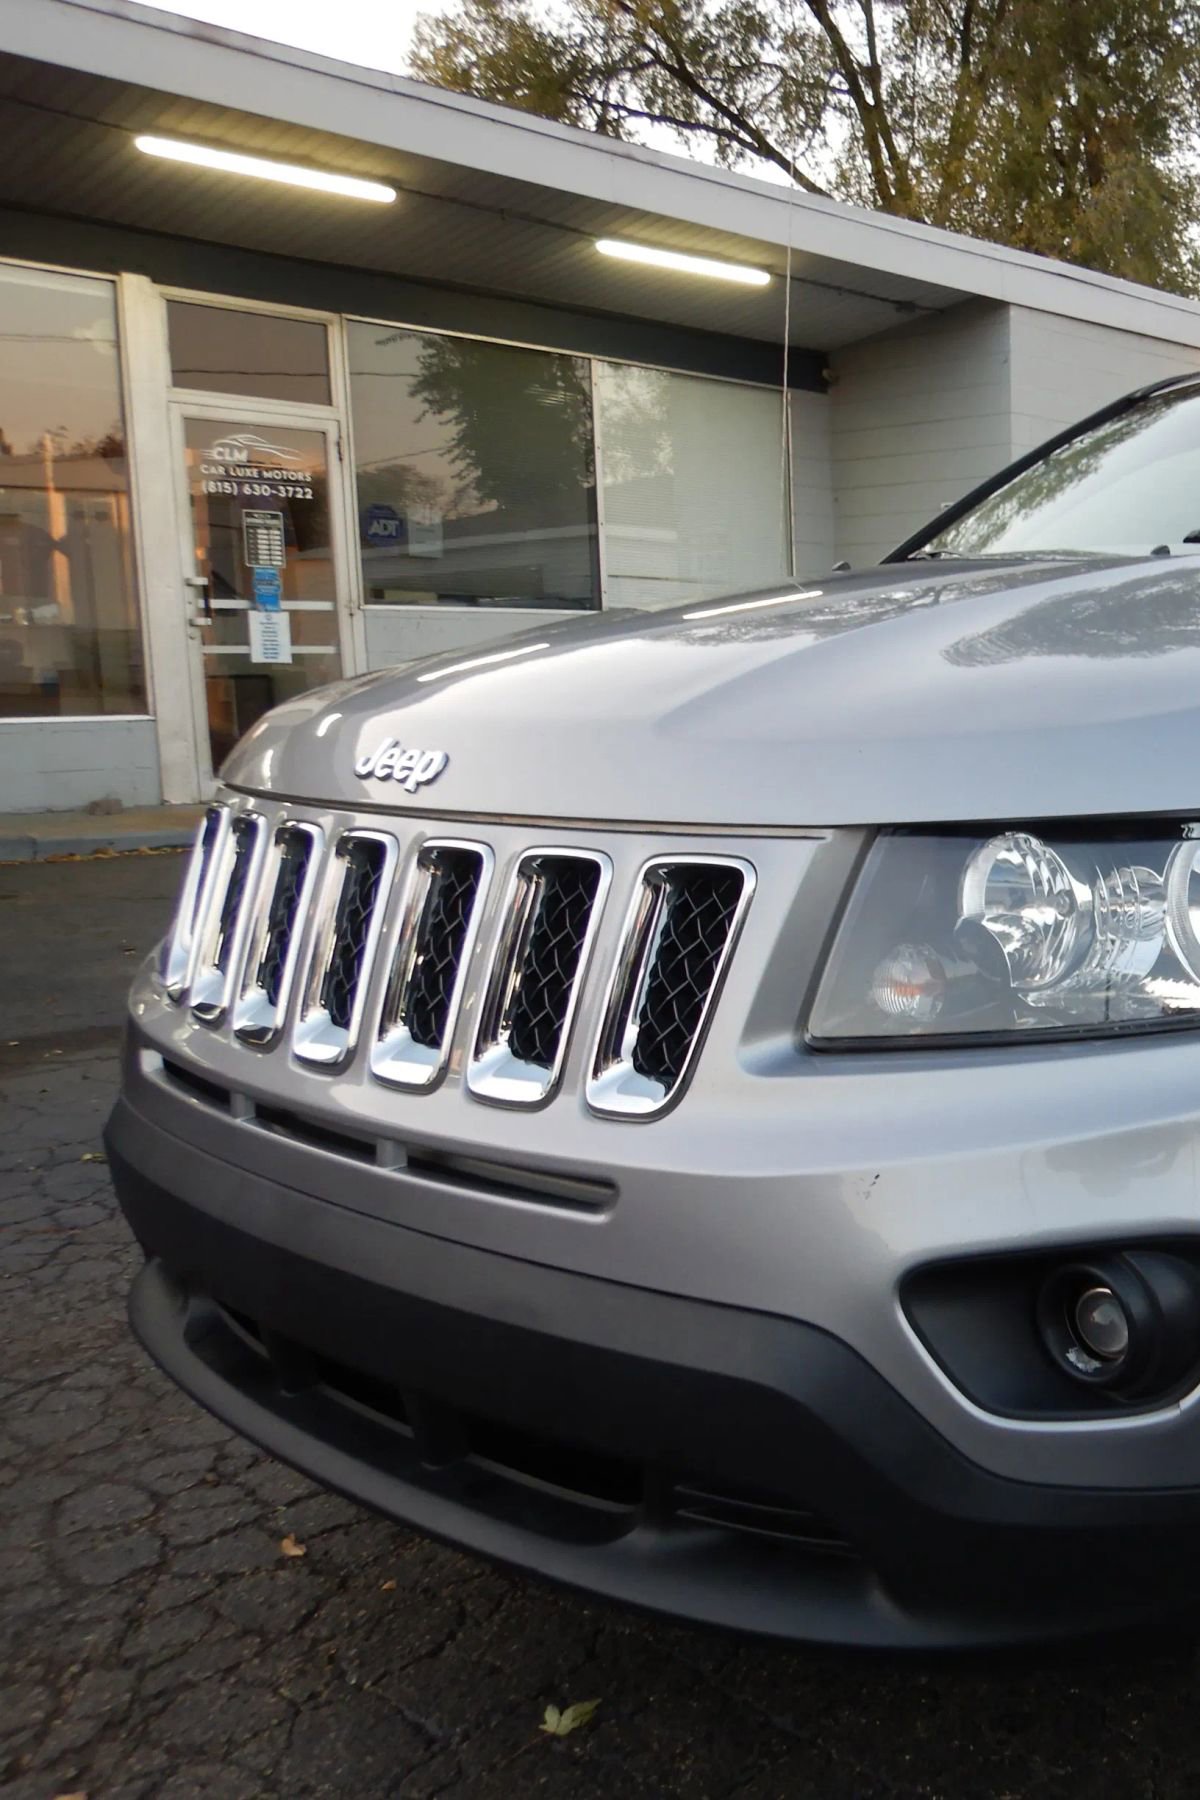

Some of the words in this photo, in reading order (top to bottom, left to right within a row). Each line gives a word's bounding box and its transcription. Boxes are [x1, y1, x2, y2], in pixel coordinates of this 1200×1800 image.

[213, 446, 248, 462] CLM
[200, 464, 226, 475] CAR
[230, 467, 260, 478] LUXE
[263, 470, 313, 482] MOTORS
[202, 480, 238, 496] (815)
[243, 483, 314, 499] 630-3722
[367, 519, 399, 537] ADT
[354, 737, 449, 793] Jeep
